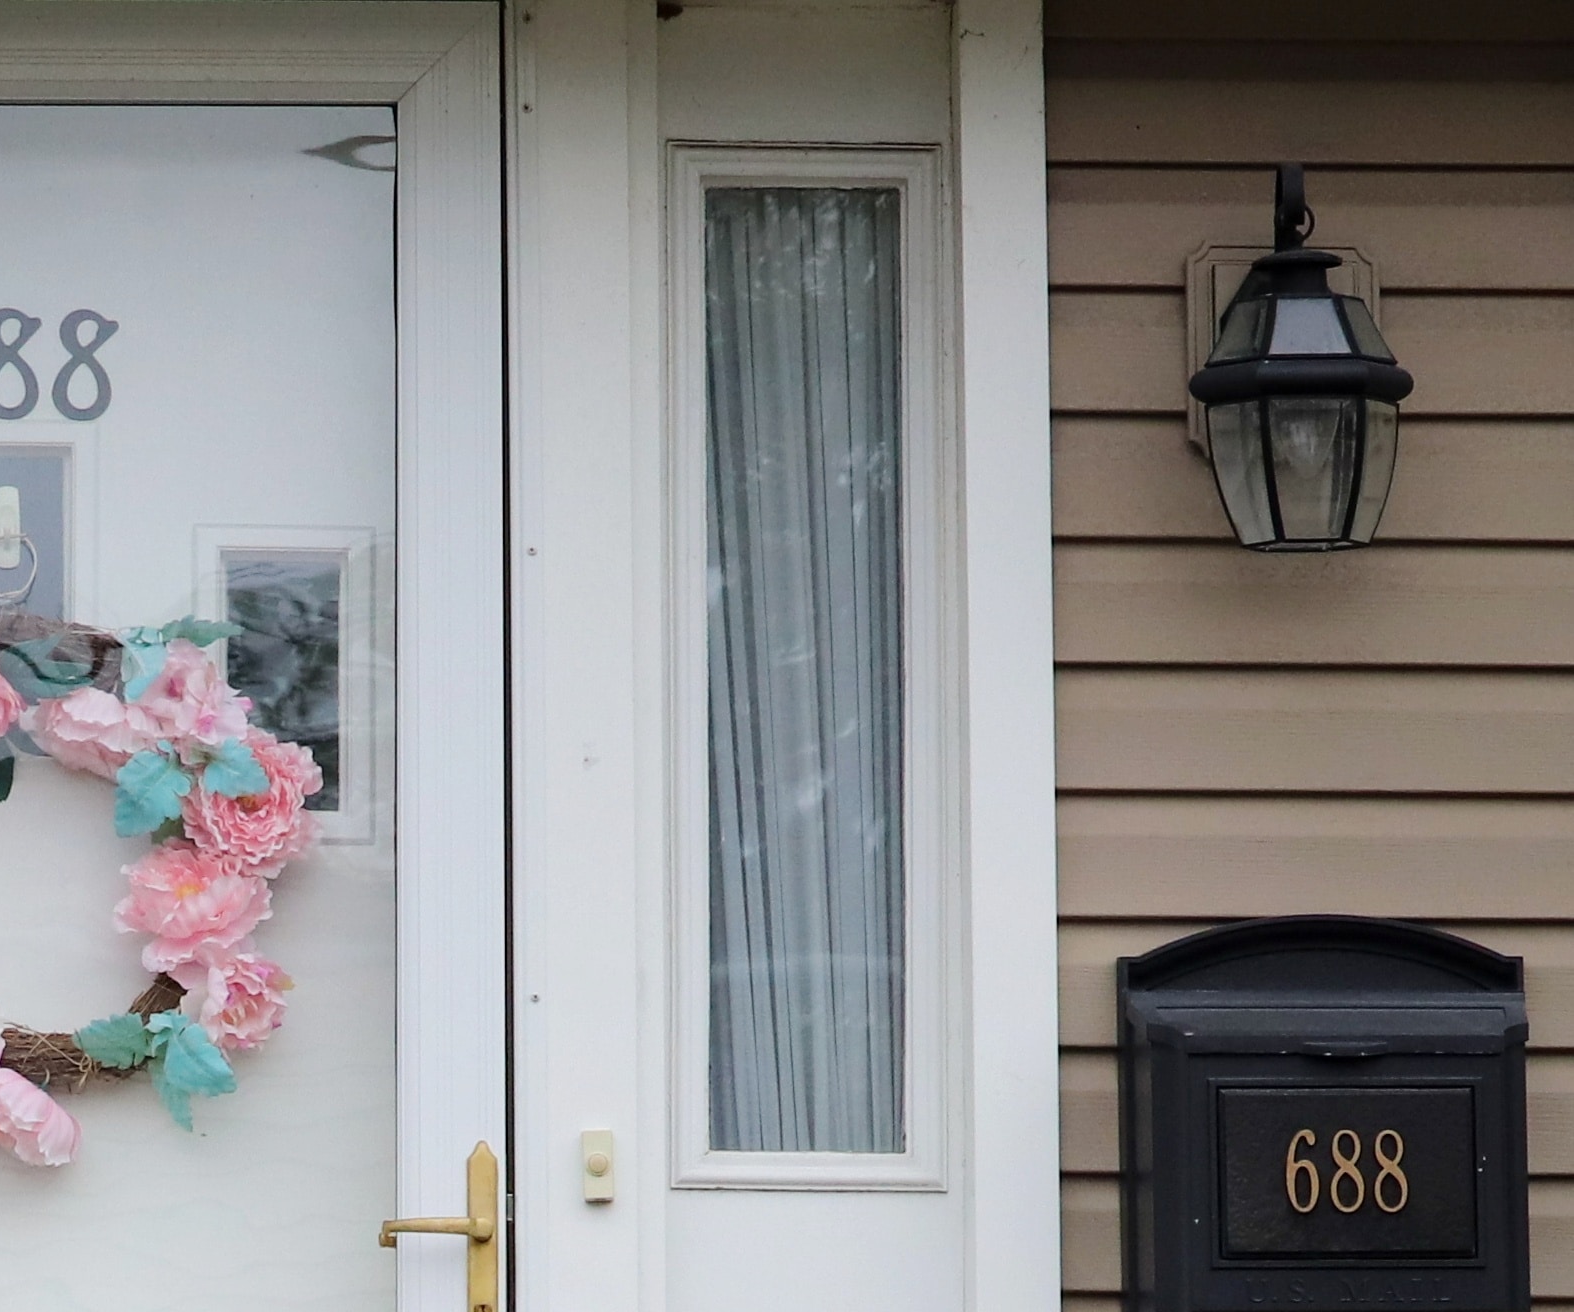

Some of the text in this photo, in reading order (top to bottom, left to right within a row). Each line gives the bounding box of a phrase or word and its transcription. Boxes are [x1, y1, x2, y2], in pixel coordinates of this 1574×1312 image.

[1286, 1128, 1409, 1213] 688
[1246, 1277, 1454, 1303] U.S. MAIL
